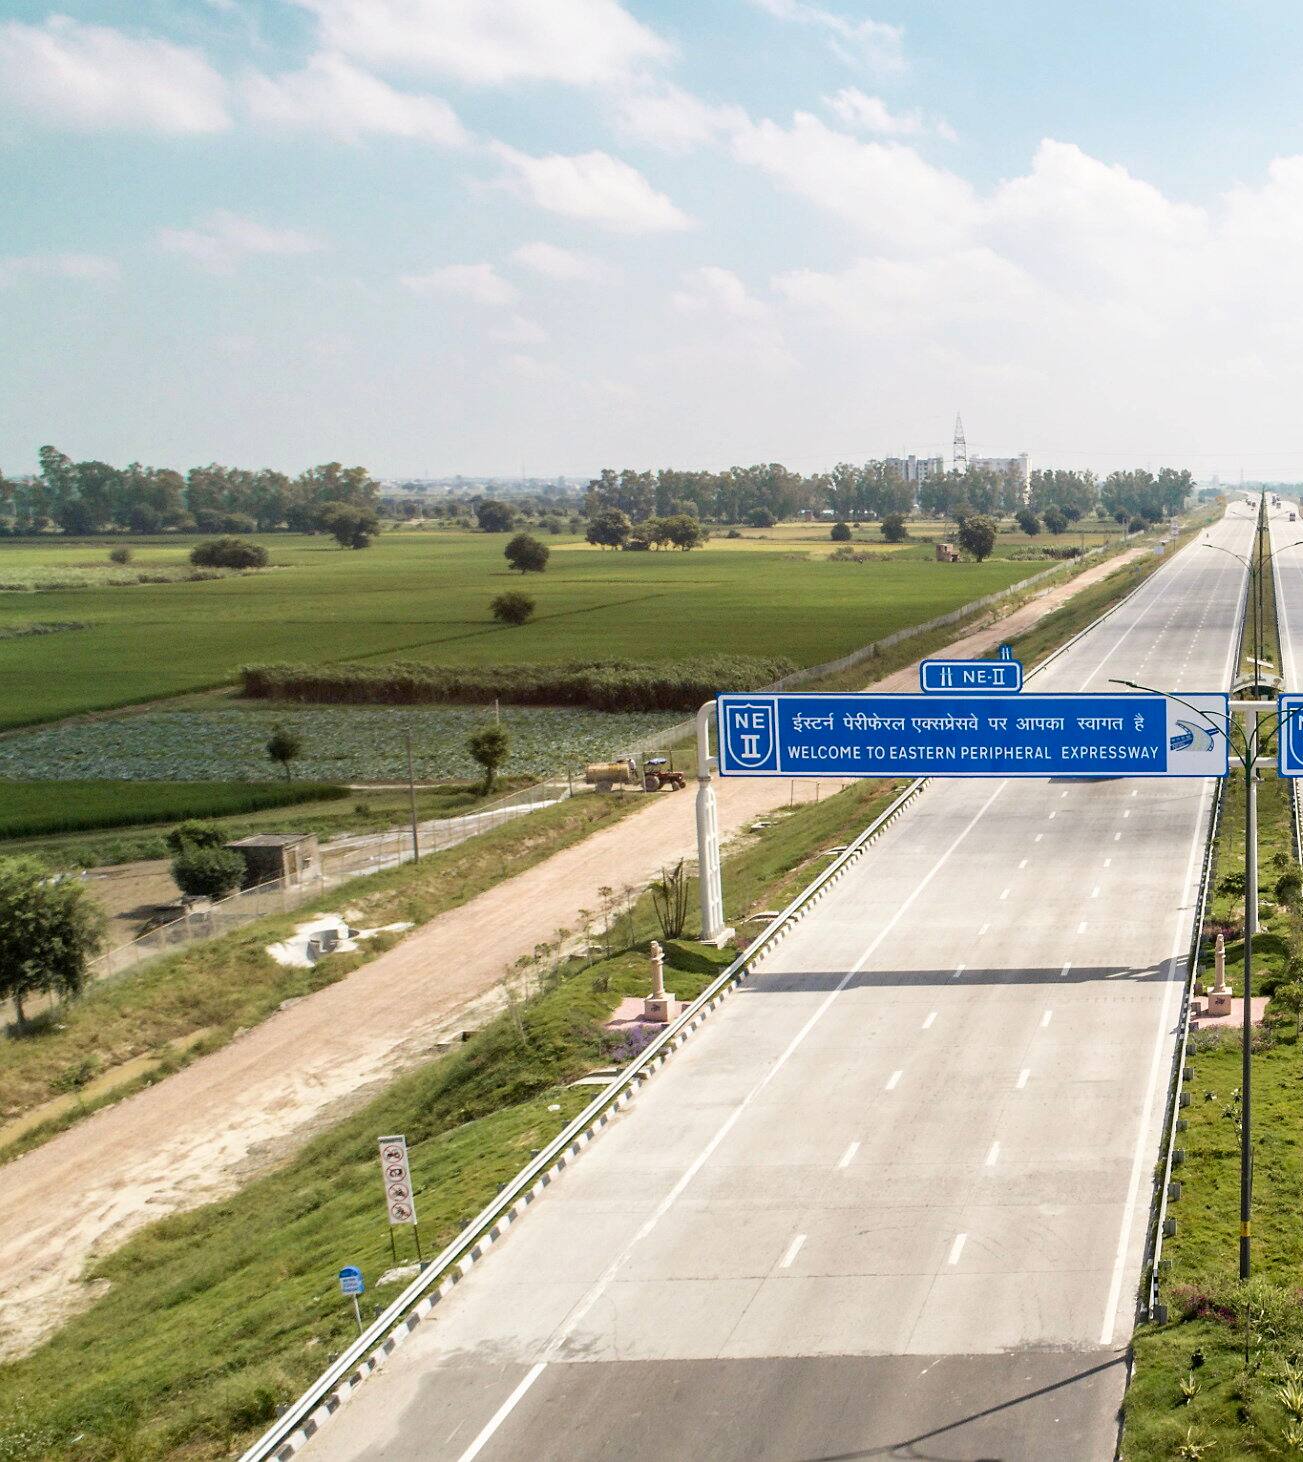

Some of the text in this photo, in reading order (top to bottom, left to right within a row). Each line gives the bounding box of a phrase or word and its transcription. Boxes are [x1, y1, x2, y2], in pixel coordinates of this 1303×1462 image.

[963, 668, 1005, 685] NE-II
[735, 713, 765, 729] NE
[792, 712, 1145, 733] ईस्टर्न पेरीफेरल एक्सप्रेसवे पर आपका स्वागत है
[740, 734, 760, 758] II
[788, 745, 861, 759] WELCOME
[866, 745, 886, 759] TO
[890, 745, 956, 760] EASTERN
[961, 745, 1051, 759] PERIPHERAL
[1062, 745, 1159, 759] EXPRESSWAY
